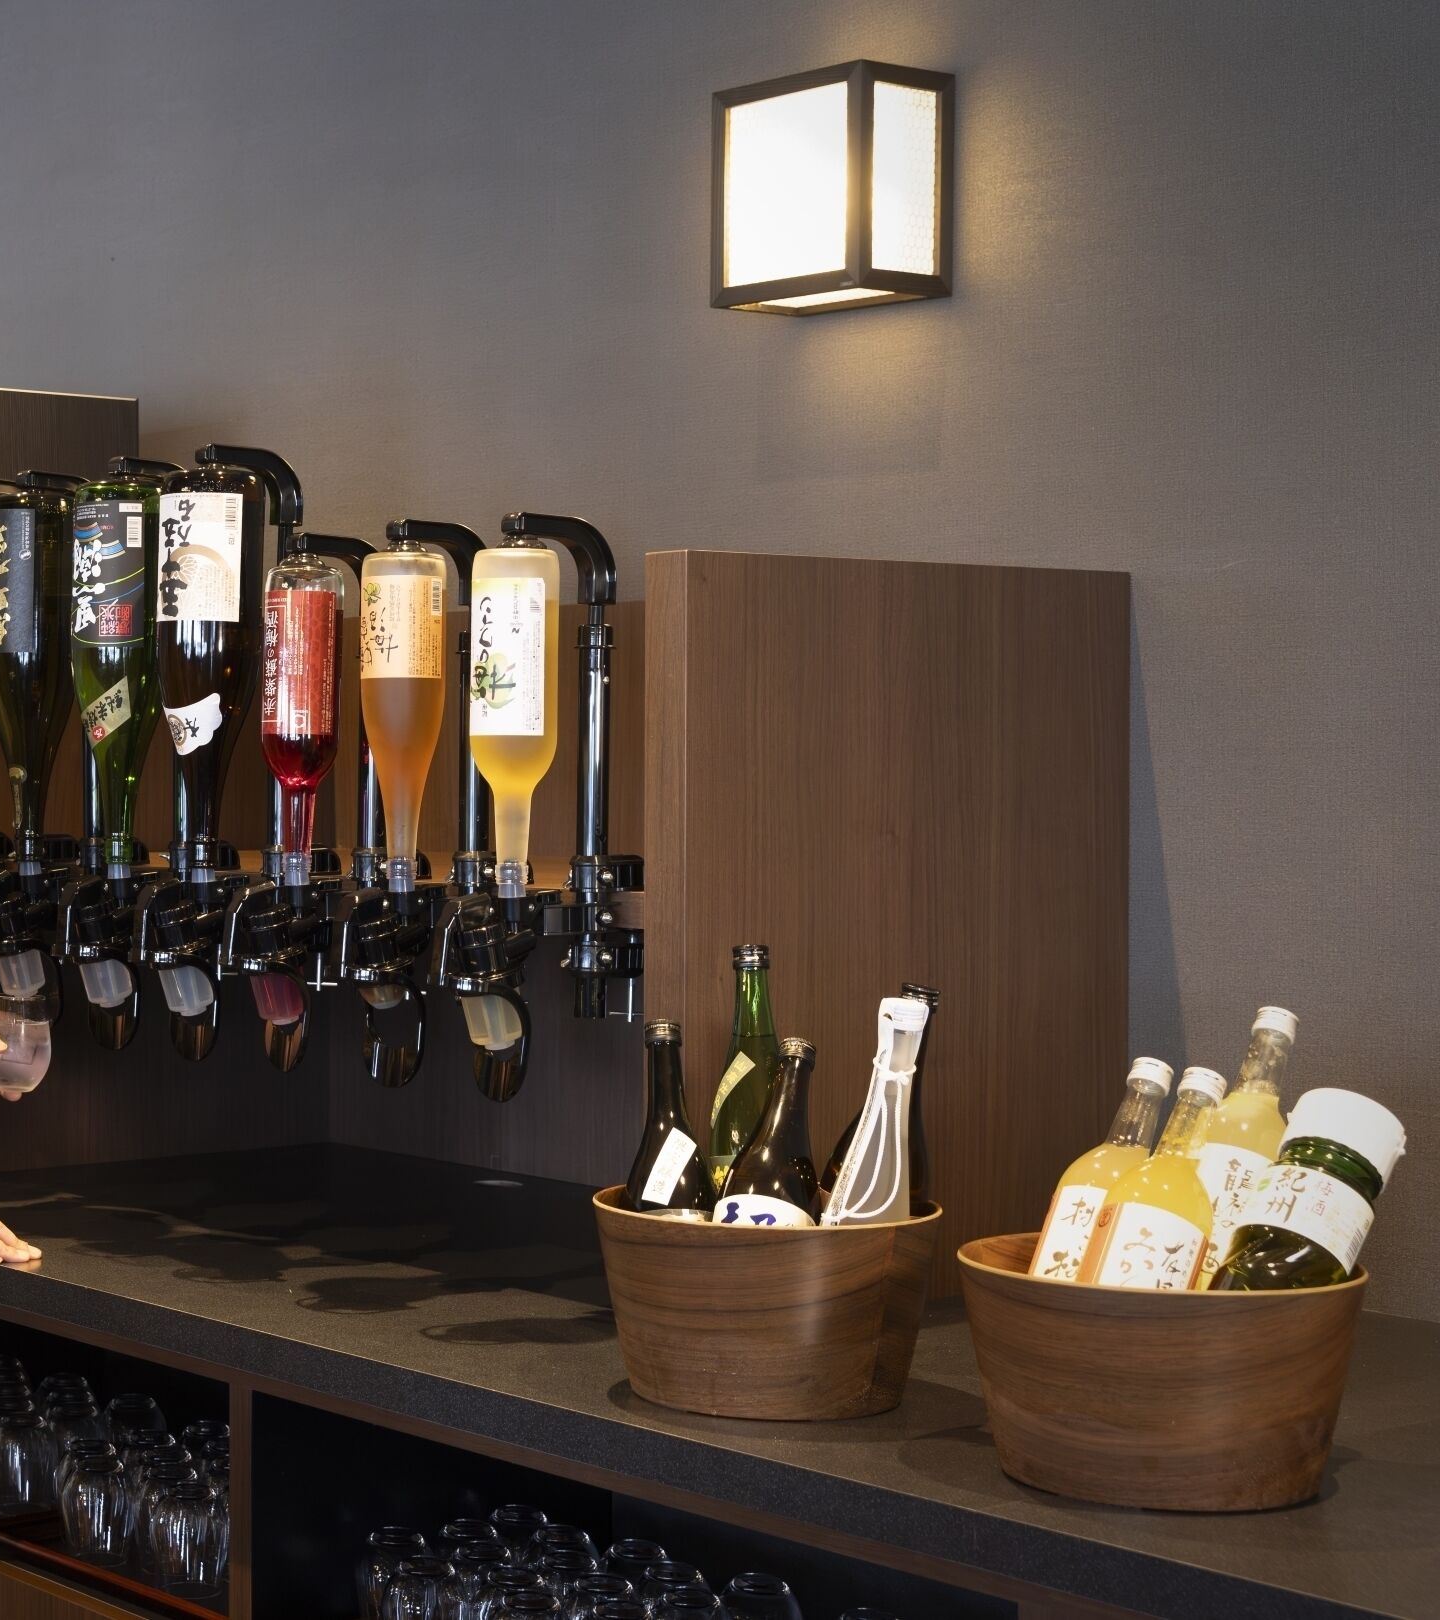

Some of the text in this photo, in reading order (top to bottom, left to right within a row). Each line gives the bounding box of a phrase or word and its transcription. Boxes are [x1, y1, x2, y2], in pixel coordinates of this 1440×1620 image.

[263, 611, 279, 715] 赤紫蘇の梅酒
[1265, 1168, 1307, 1223] 紀州
